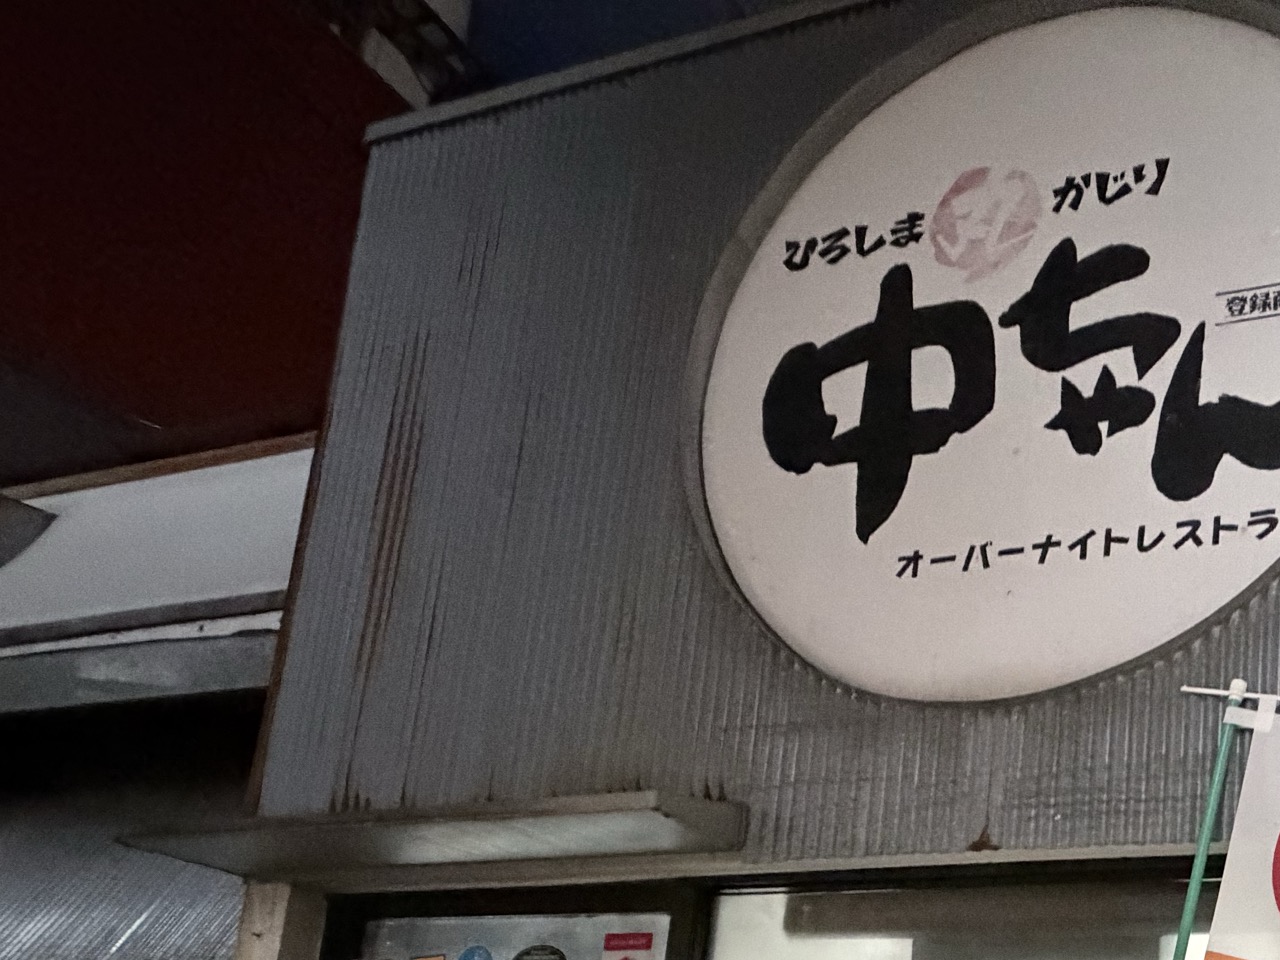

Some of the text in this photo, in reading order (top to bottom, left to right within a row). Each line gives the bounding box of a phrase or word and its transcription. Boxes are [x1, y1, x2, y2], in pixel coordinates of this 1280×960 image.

[1052, 157, 1171, 213] かじり
[783, 211, 926, 272] ひろしま
